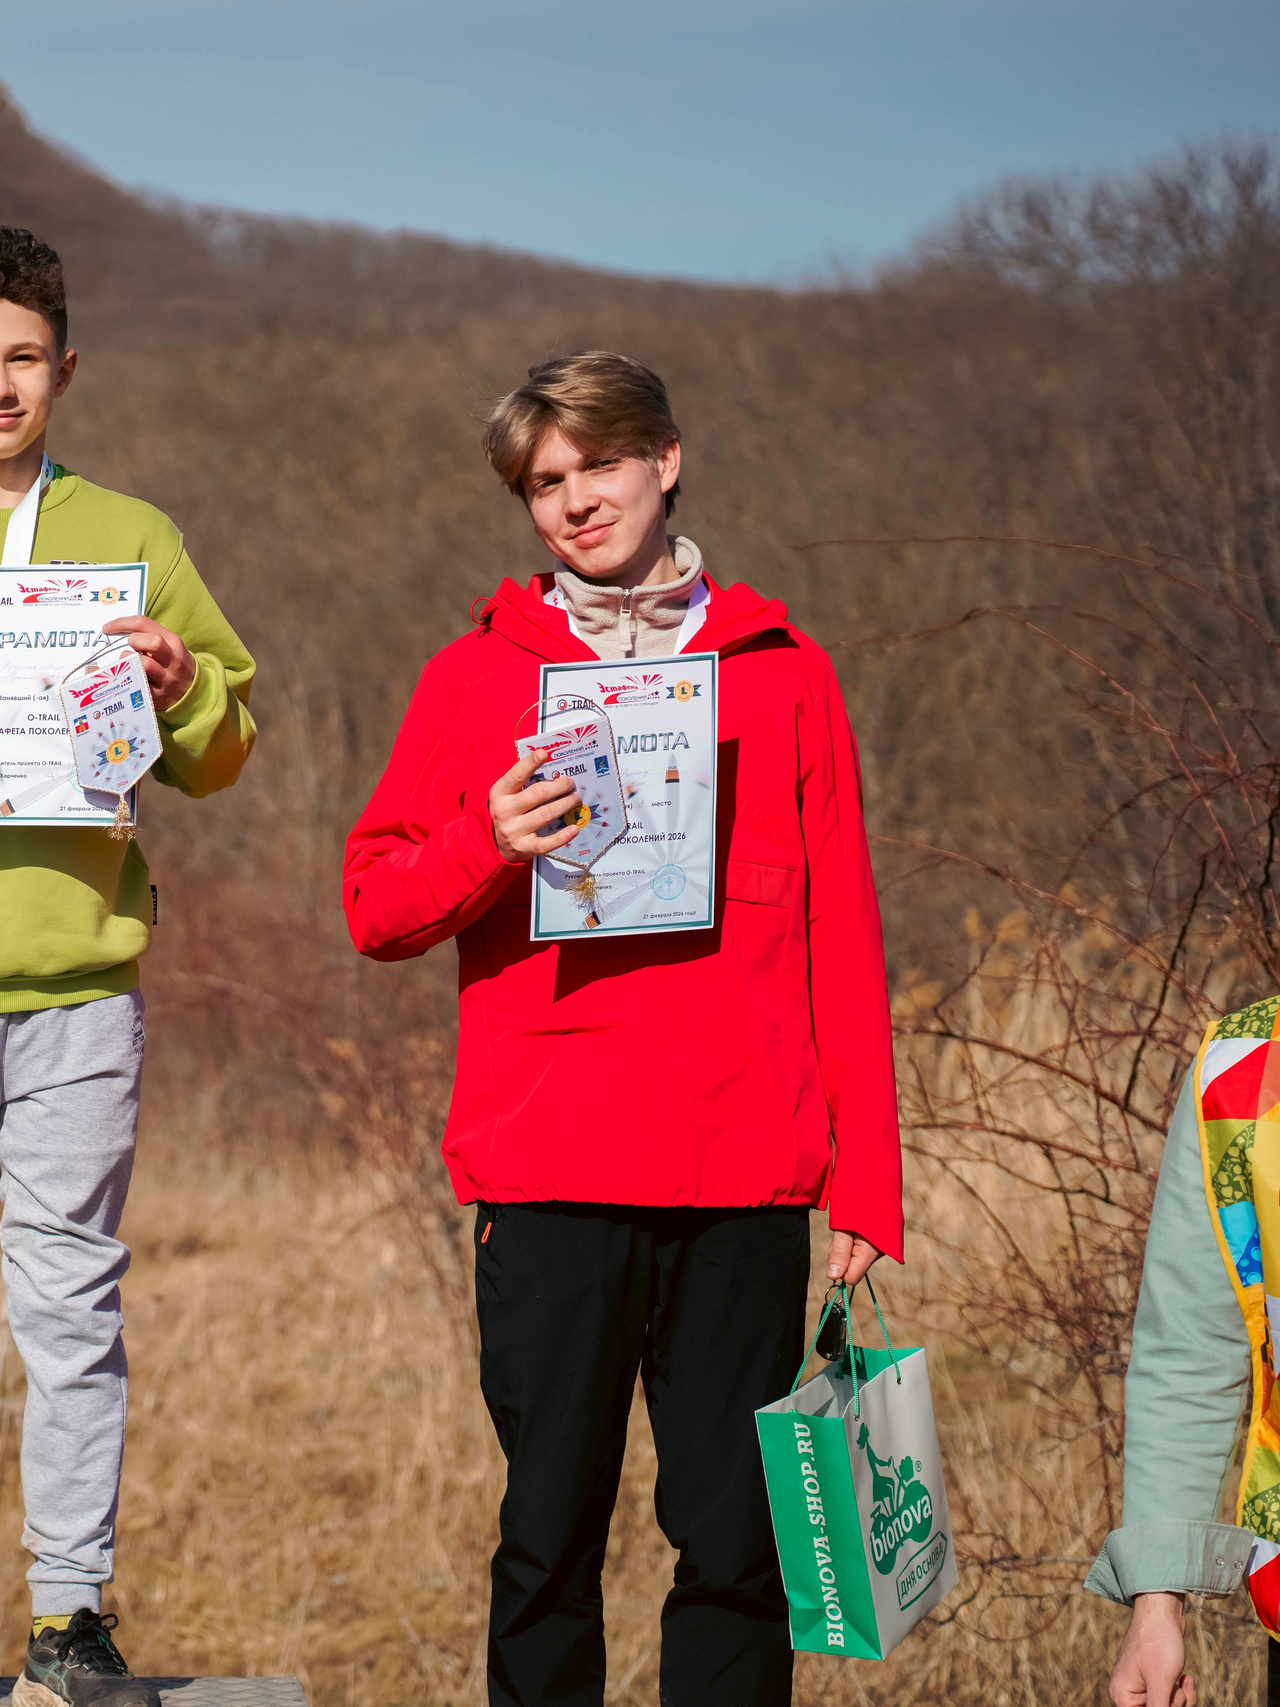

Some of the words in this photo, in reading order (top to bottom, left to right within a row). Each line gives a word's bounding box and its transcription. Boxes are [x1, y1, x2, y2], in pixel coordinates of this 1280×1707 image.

[68, 680, 109, 698] Эстафета
[27, 713, 61, 722] O-TRAIL
[617, 731, 690, 754] МОТА
[117, 780, 129, 788] 2026
[627, 822, 644, 830] RAIL
[614, 833, 666, 845] ПОКОЛЕНИЙ
[667, 832, 686, 841] 2026
[578, 848, 591, 857] 2026
[794, 1422, 845, 1648] BIONOVA-SHOP.RU
[871, 1494, 933, 1562] bionova
[900, 1570, 917, 1600] ДНЯ
[915, 1542, 944, 1580] ОСНОВА
